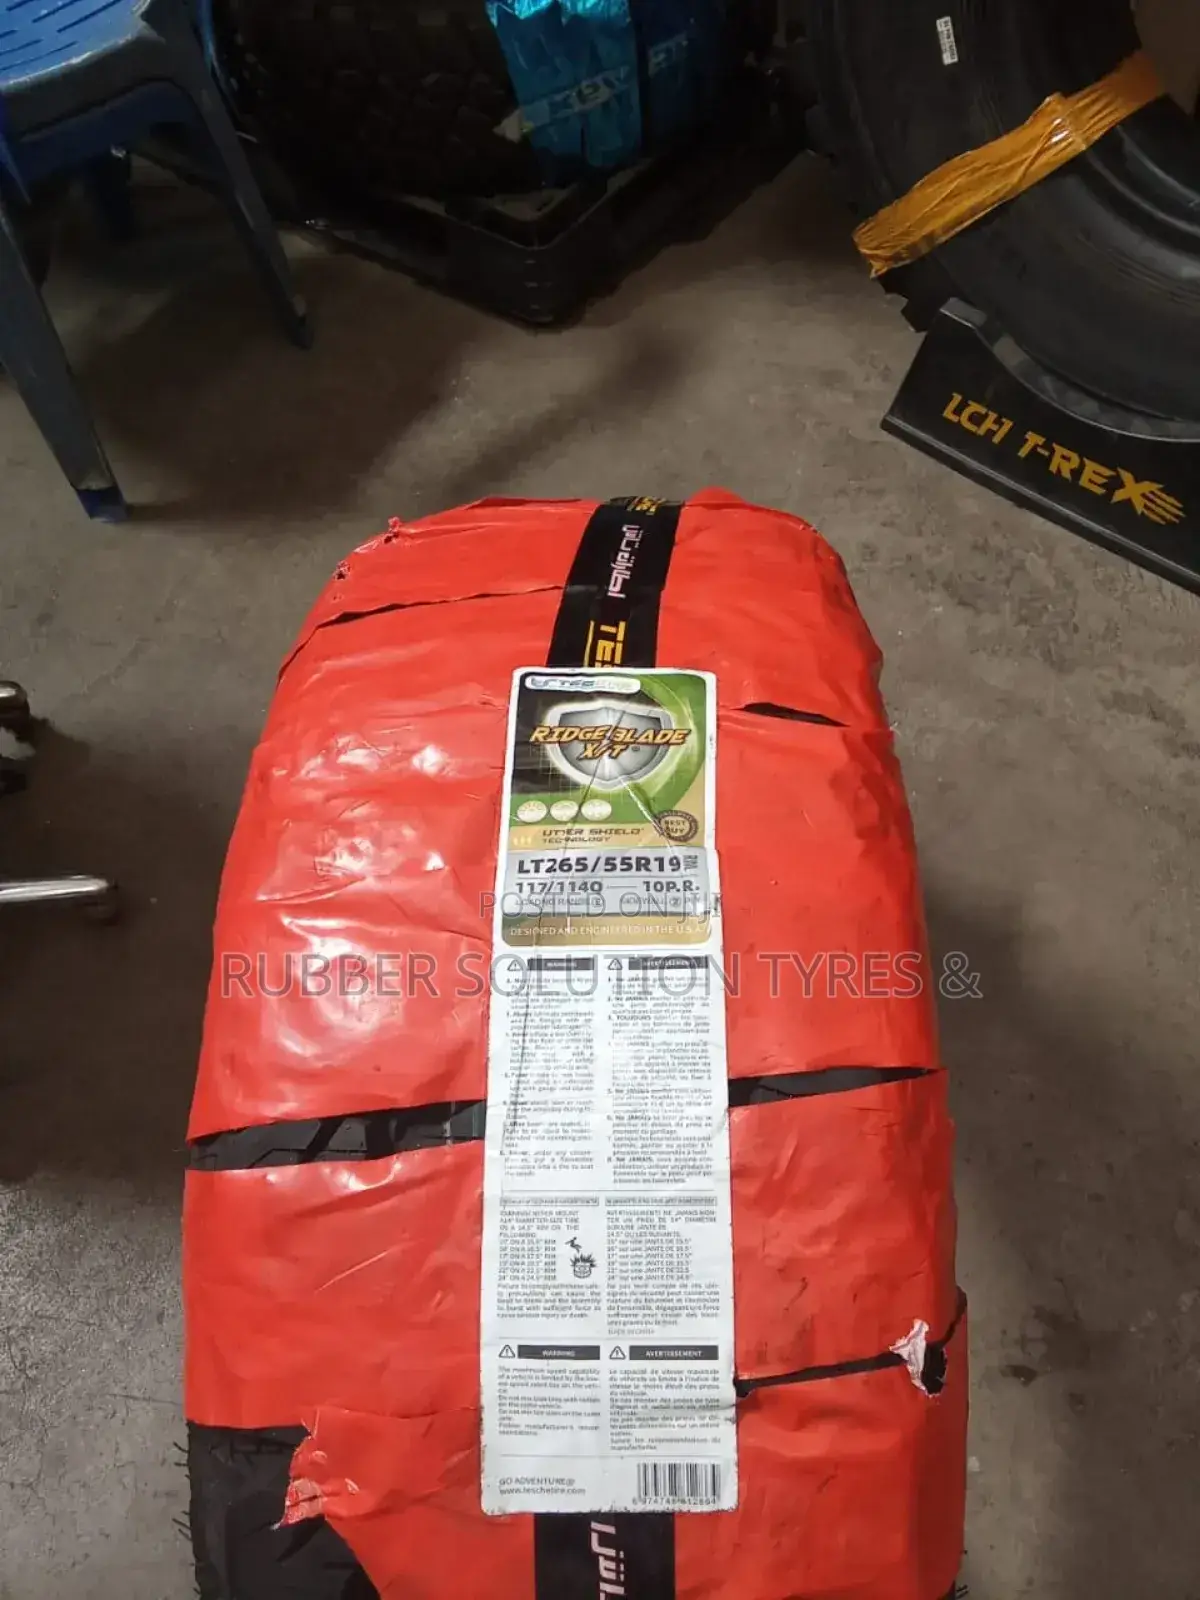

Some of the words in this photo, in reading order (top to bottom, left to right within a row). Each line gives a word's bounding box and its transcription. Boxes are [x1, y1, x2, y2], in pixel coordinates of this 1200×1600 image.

[942, 392, 1014, 444] LCH
[1017, 431, 1187, 525] T-REX
[594, 620, 627, 667] TE
[530, 725, 609, 744] RIDGE
[611, 727, 692, 745] BLADE
[590, 827, 641, 836] SHIELD
[517, 855, 682, 875] LT265/55R19
[643, 880, 700, 893] 10P.R.
[510, 926, 559, 937] DESIGNED
[655, 925, 678, 935] THE
[645, 1349, 703, 1358] AVERTISSEMENT
